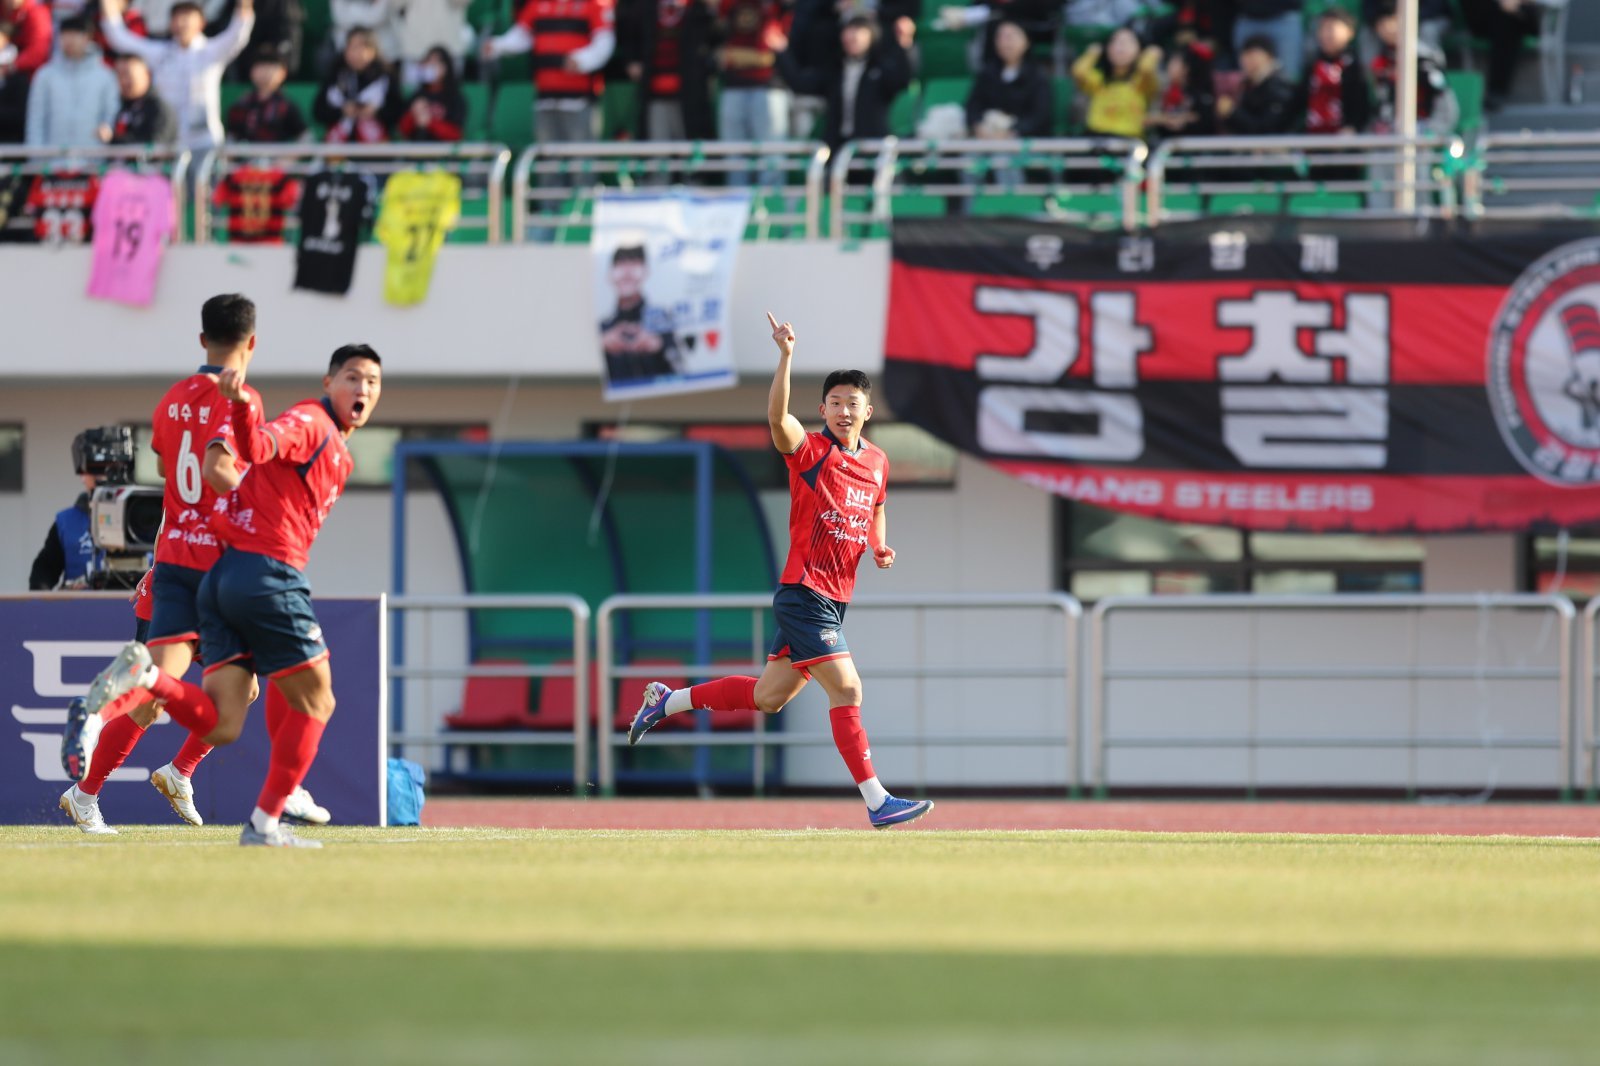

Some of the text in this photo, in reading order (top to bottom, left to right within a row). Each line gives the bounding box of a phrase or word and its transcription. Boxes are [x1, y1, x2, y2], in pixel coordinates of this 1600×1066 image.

[112, 218, 144, 262] 19
[176, 430, 202, 505] 6
[846, 486, 874, 506] NH
[1174, 481, 1374, 511] STEELERS
